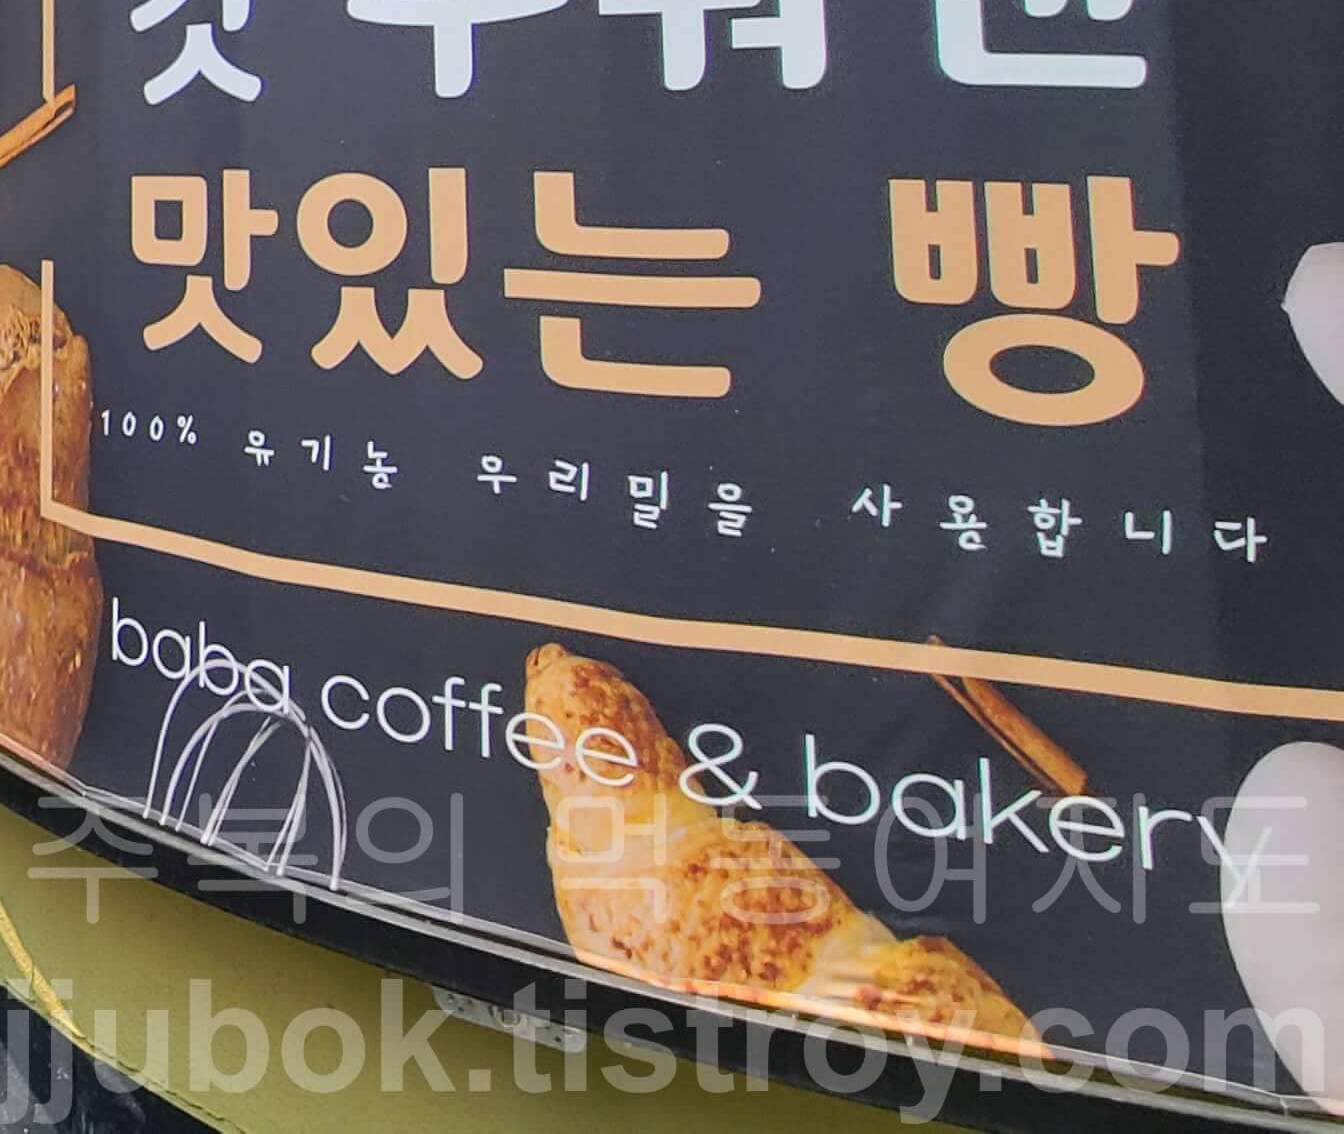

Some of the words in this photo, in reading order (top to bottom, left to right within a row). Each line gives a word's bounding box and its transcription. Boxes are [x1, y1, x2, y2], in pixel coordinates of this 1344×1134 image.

[129, 167, 762, 399] 맛있는
[888, 175, 1180, 427] 빵
[100, 408, 198, 446] 100%
[243, 429, 398, 489] 유기농
[476, 454, 752, 537] 우리밀을
[852, 483, 1268, 563] 사용합니다
[111, 596, 291, 714] baba
[320, 677, 637, 787] coffee
[678, 723, 763, 810] &
[802, 733, 1273, 911] bakery
